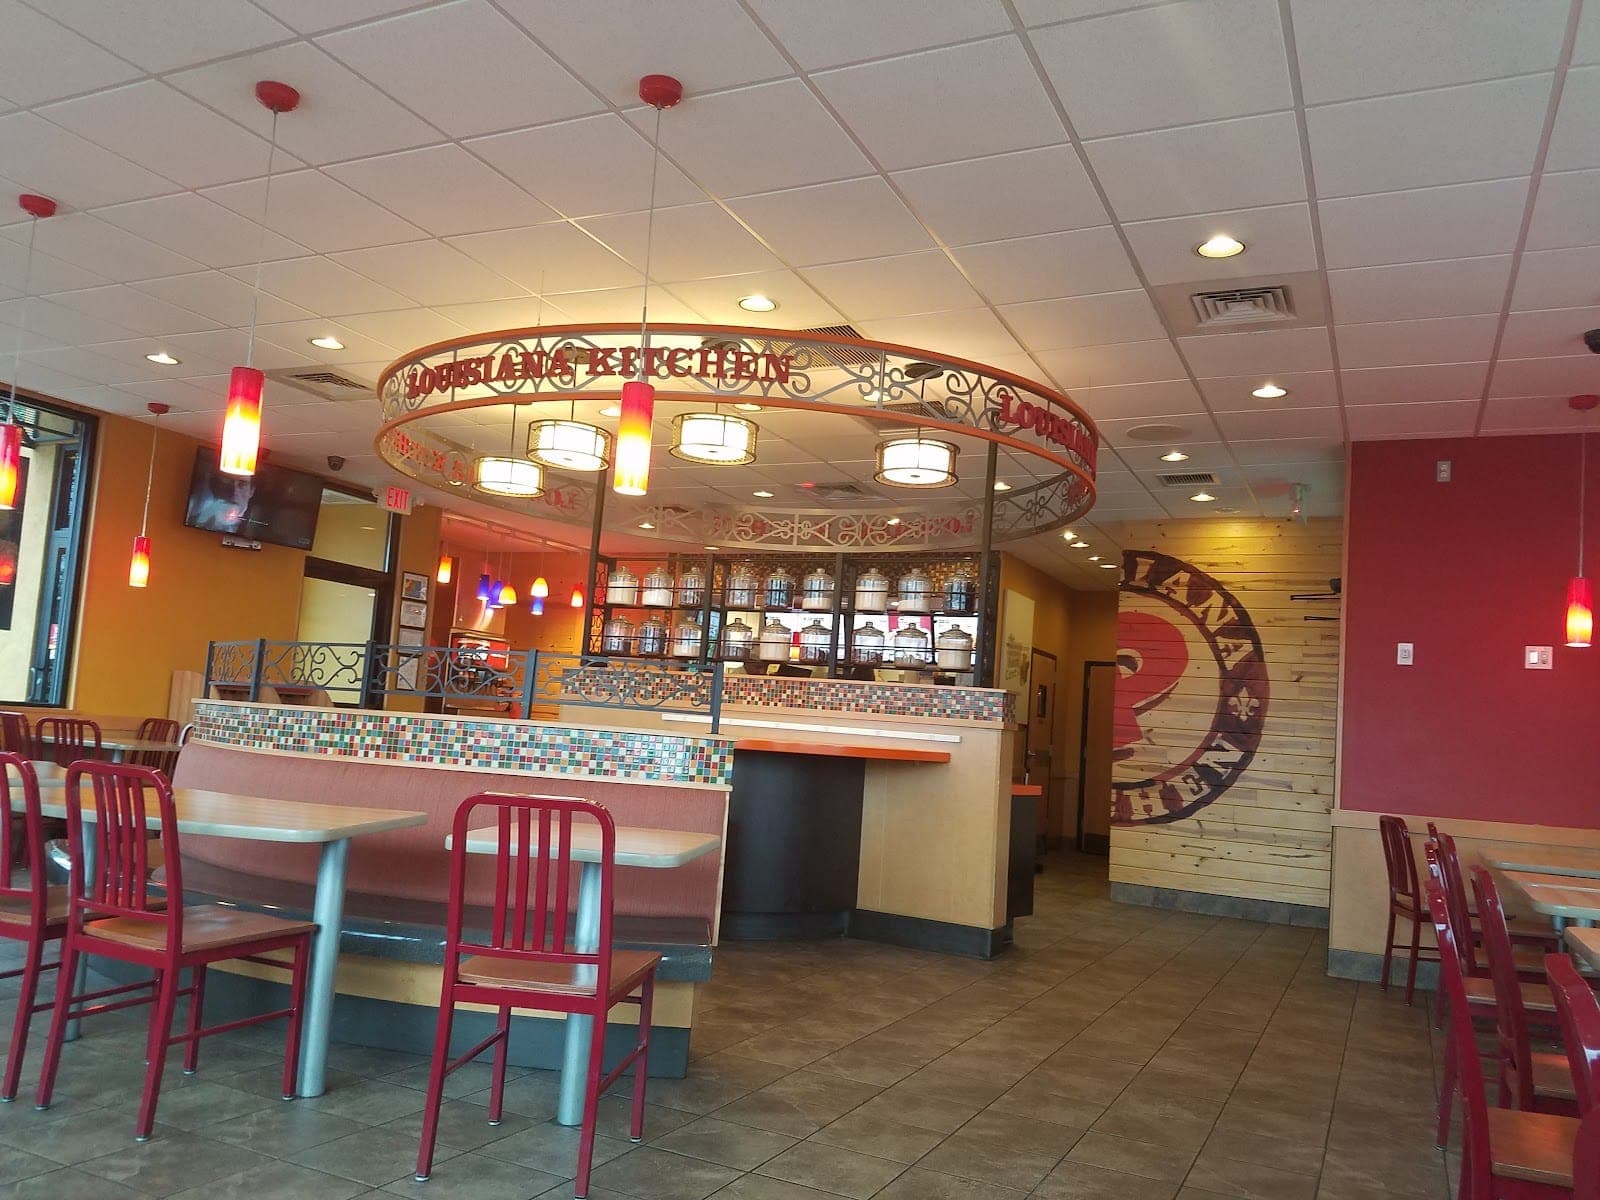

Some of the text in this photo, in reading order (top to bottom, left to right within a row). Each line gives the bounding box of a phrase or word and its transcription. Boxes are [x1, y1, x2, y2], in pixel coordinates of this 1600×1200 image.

[407, 347, 794, 399] LOUISIANA KITCHEN
[387, 487, 409, 510] EXIT
